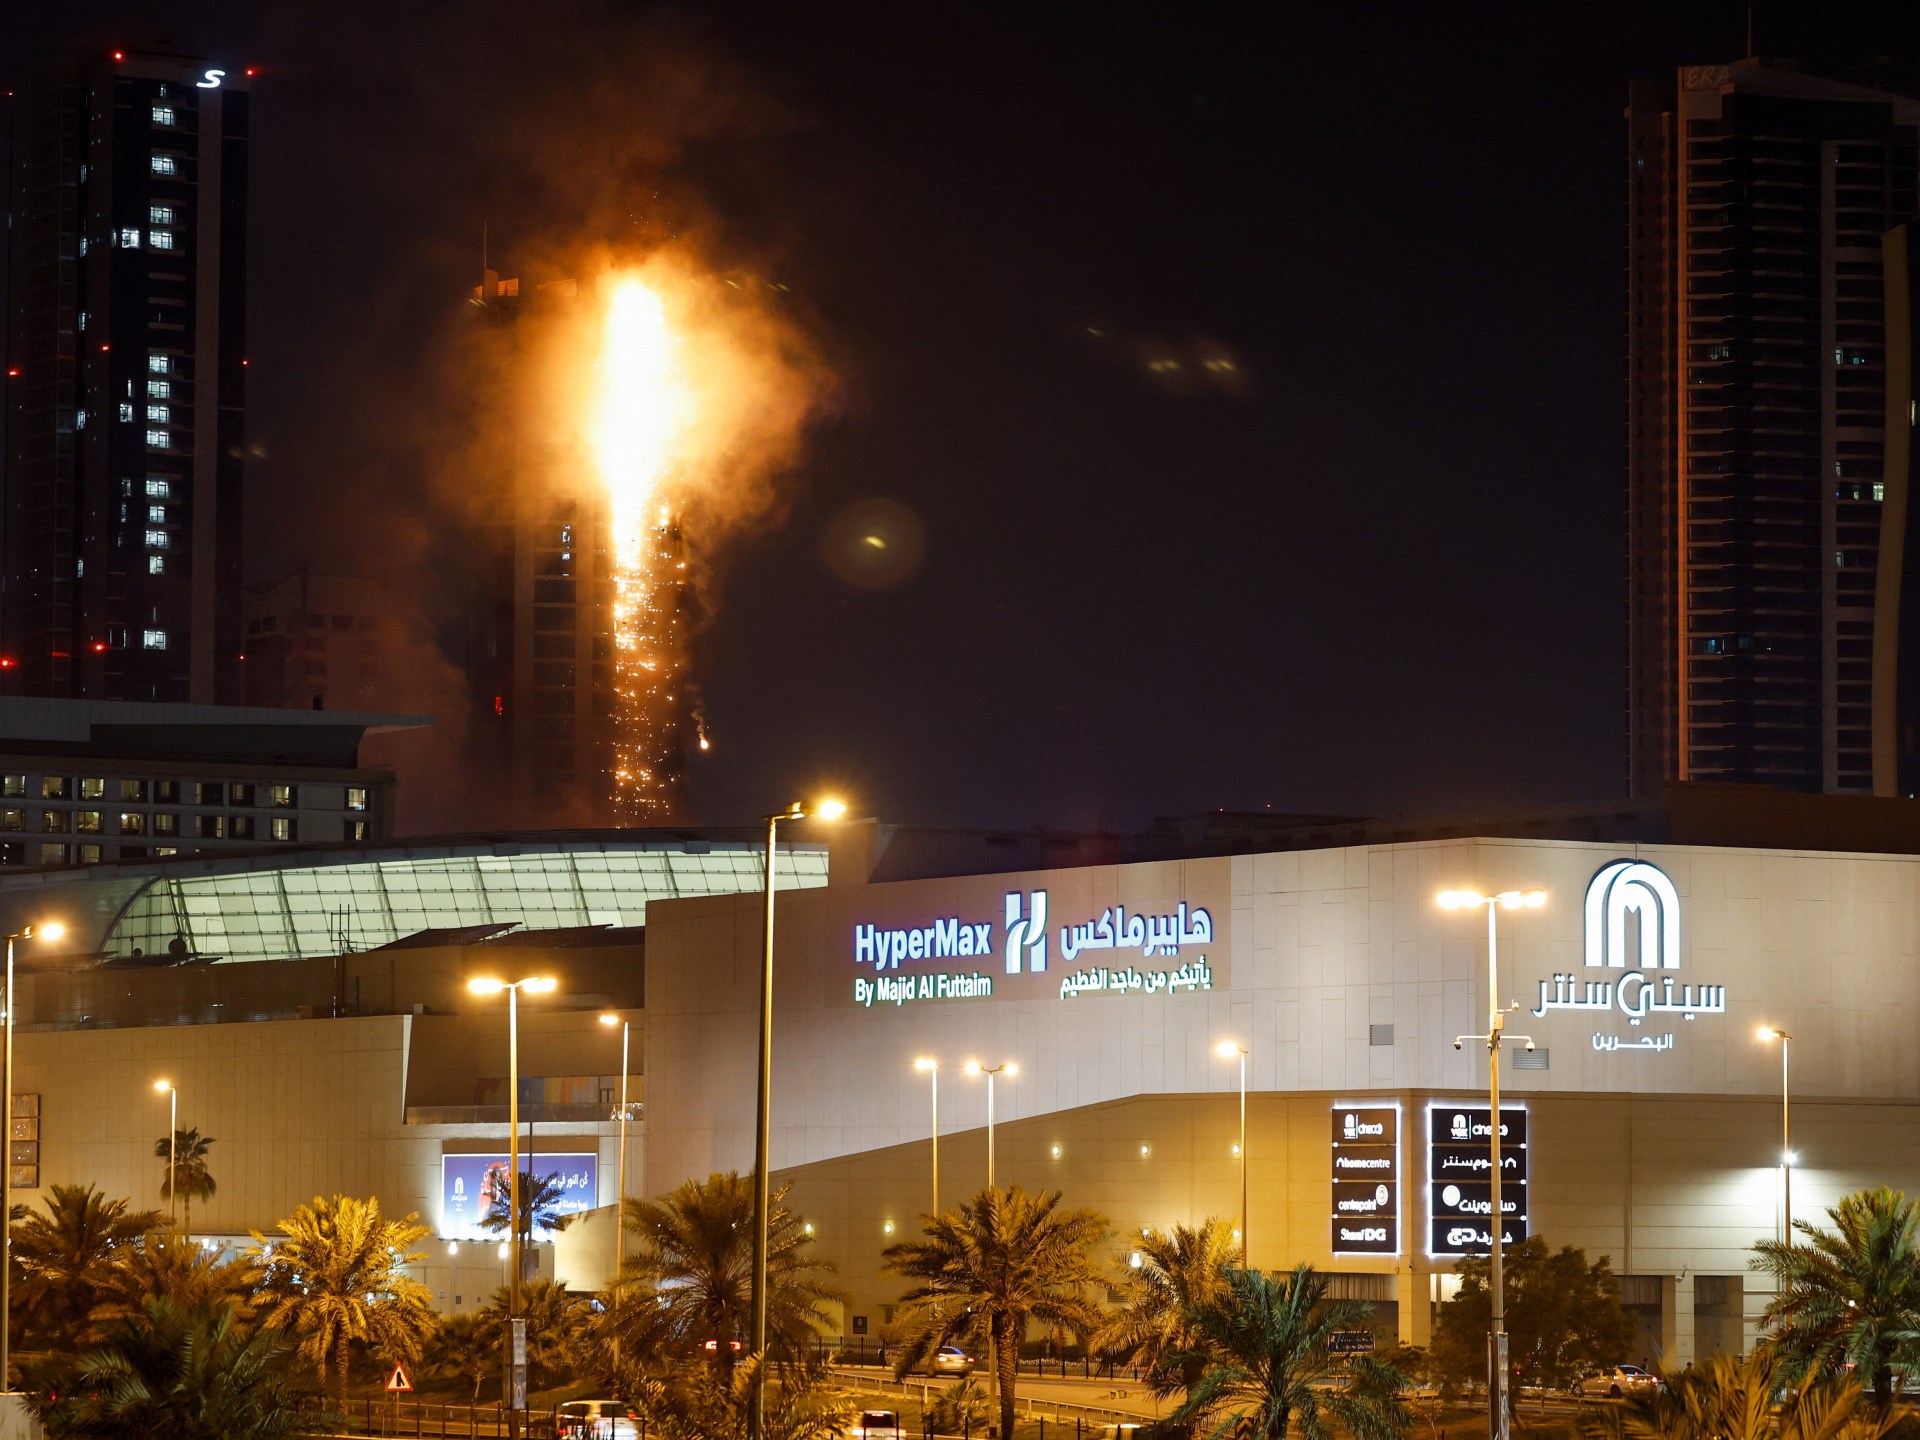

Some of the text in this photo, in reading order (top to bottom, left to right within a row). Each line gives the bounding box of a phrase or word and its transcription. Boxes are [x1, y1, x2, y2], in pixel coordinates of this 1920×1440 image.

[855, 917, 992, 971] HyperMax
[1060, 903, 1212, 962] هايبرماكس
[855, 971, 992, 1008] By Majid Al Futtaim
[1060, 967, 1108, 1000] الفطيم
[1110, 967, 1142, 994] ماجد
[1144, 971, 1167, 993] من
[1531, 968, 1726, 1027] سيتي سنتر
[1592, 1032, 1673, 1052] البحرين
[1364, 1227, 1387, 1242] DG
